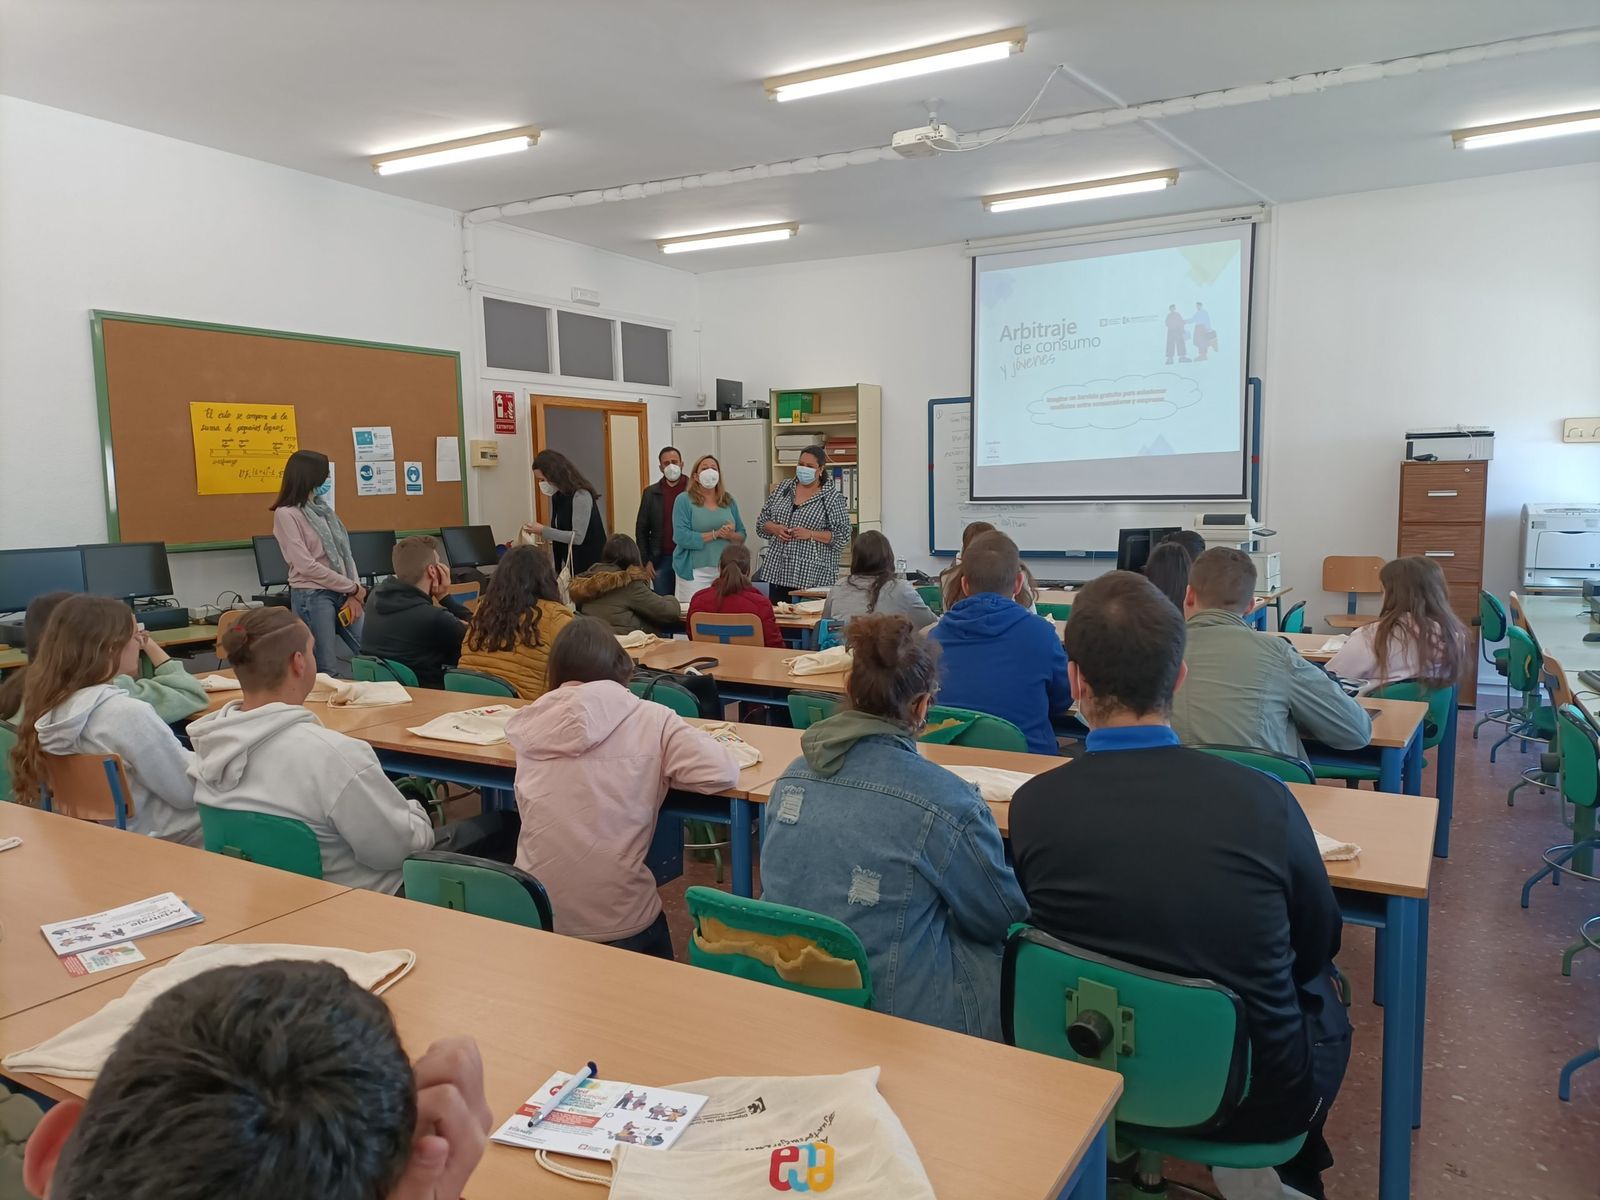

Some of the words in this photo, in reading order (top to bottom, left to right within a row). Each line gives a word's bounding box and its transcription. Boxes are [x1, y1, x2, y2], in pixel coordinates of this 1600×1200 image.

[999, 318, 1078, 342] Arbitraje
[1014, 341, 1032, 355] de
[1036, 336, 1101, 353] consumo
